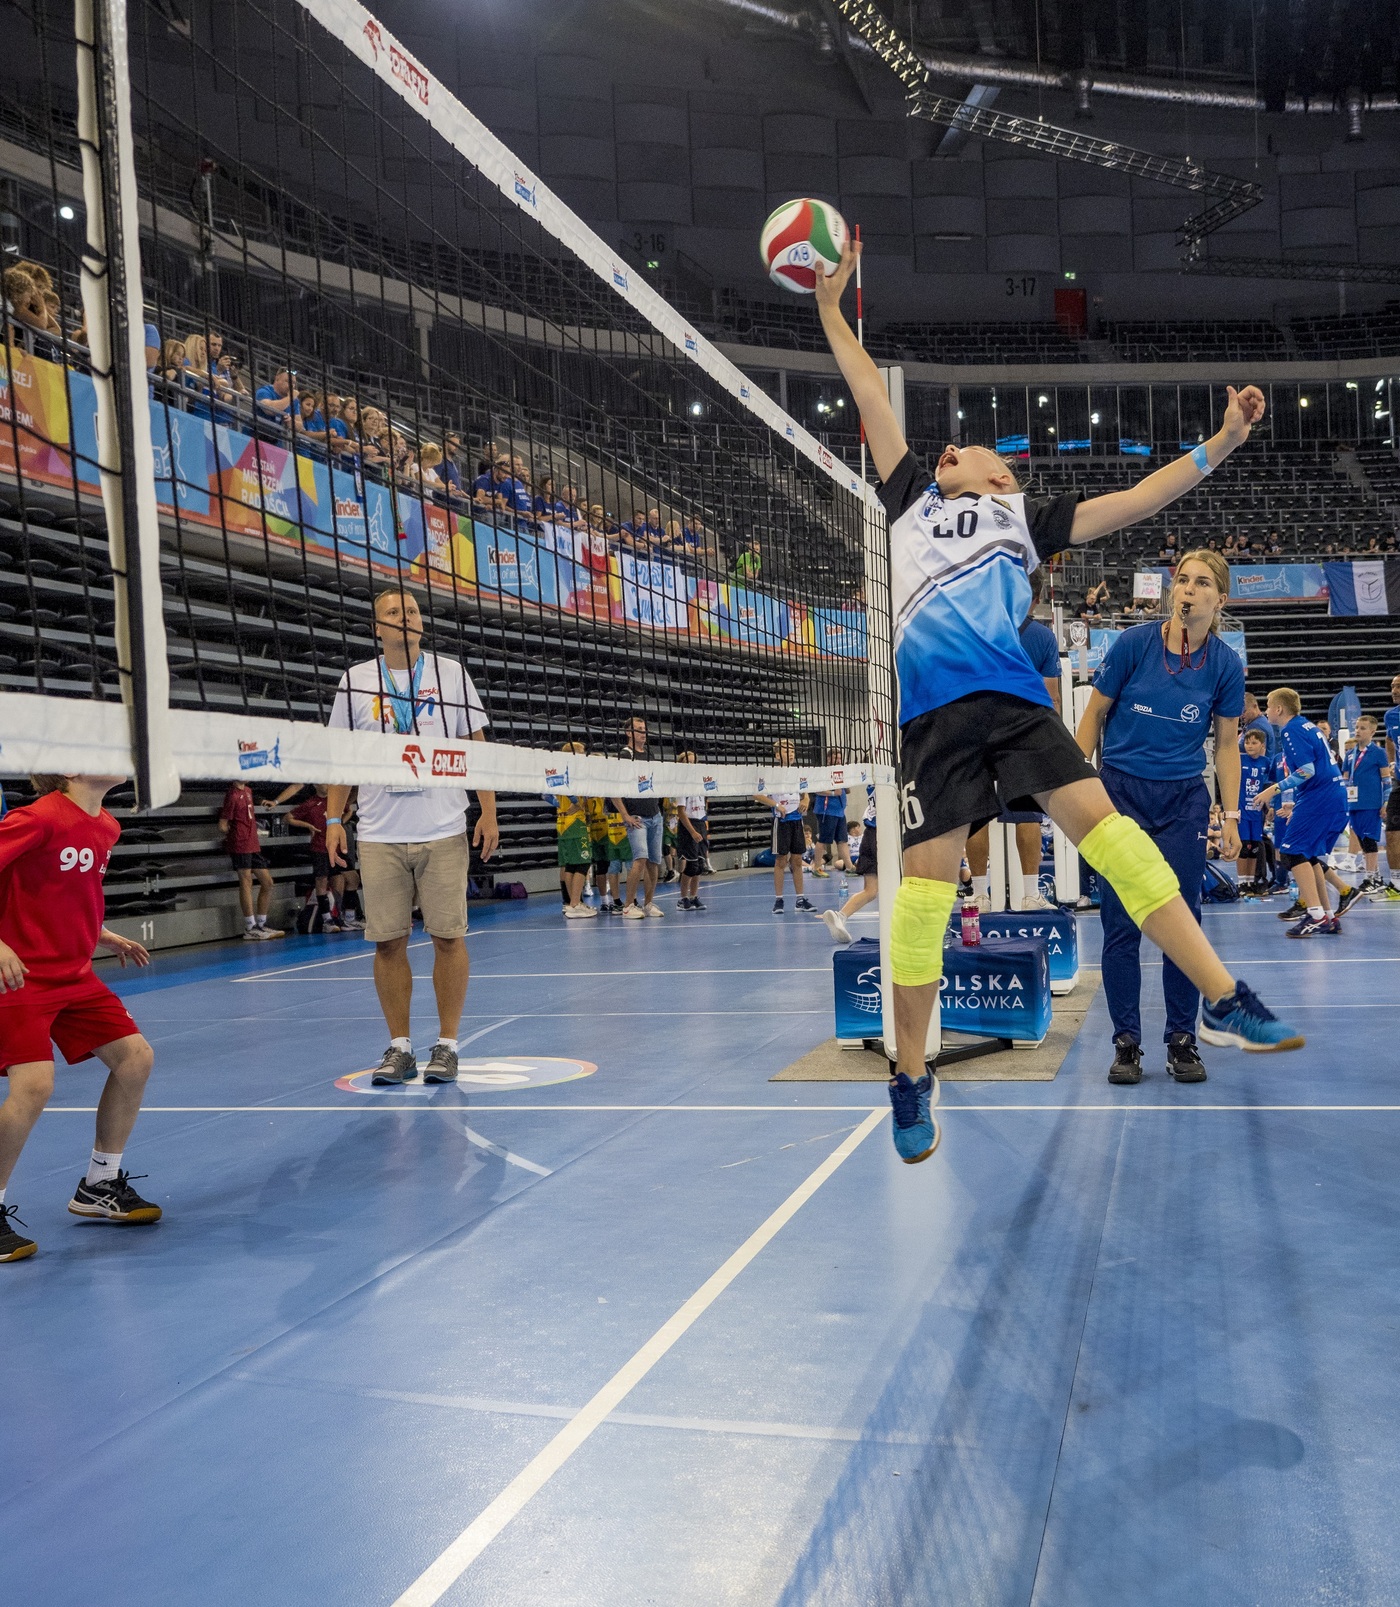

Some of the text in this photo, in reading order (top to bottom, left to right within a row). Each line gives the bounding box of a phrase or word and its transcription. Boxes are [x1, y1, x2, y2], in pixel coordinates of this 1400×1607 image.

[1005, 277, 1036, 296] 3-17
[242, 468, 284, 494] MISRZEM
[1133, 703, 1152, 713] SĘDZIA
[433, 752, 466, 773] ORLEN
[1251, 767, 1259, 778] 10
[901, 780, 925, 834] 6
[60, 847, 94, 872] 99
[141, 920, 154, 940] 11
[938, 973, 1024, 991] OLSKA
[939, 992, 1025, 1009] TKÓWKA
